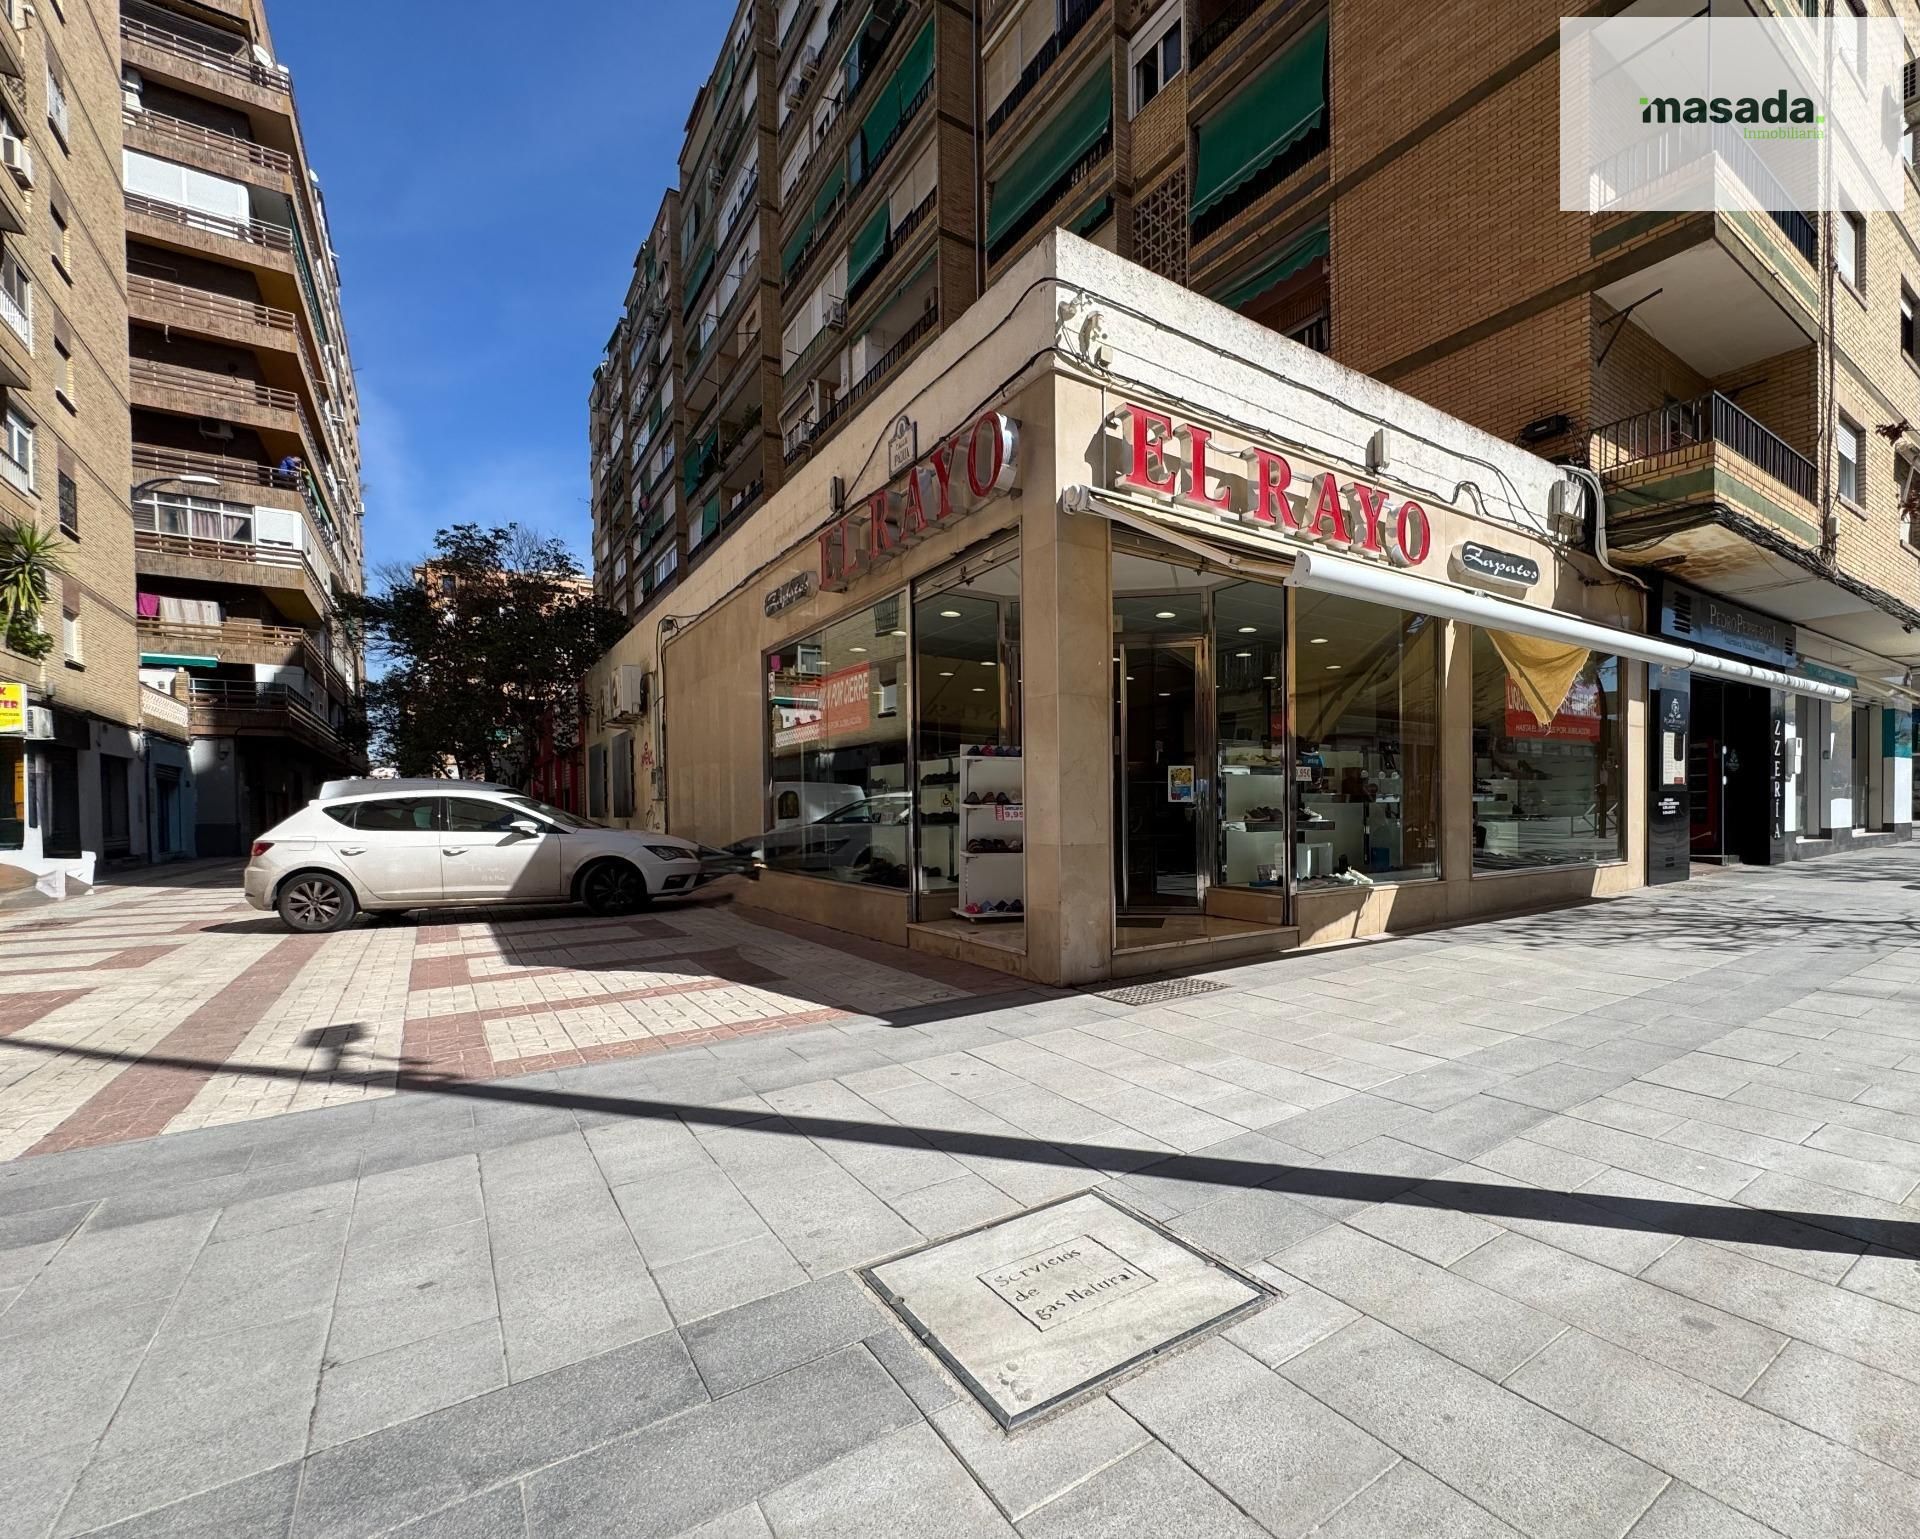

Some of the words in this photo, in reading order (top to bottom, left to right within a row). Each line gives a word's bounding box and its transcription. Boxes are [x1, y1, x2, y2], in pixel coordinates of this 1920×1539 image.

[818, 518, 859, 591] EL
[868, 410, 1004, 560] RAYO
[1125, 402, 1231, 510] EL
[1253, 447, 1431, 566] RAYO
[1463, 544, 1538, 580] Zapatos
[844, 671, 868, 704] CIERRE
[994, 1249, 1081, 1287] Servicios
[1015, 1288, 1040, 1302] de
[1035, 1300, 1066, 1321] gas
[1065, 1267, 1137, 1303] Natural
